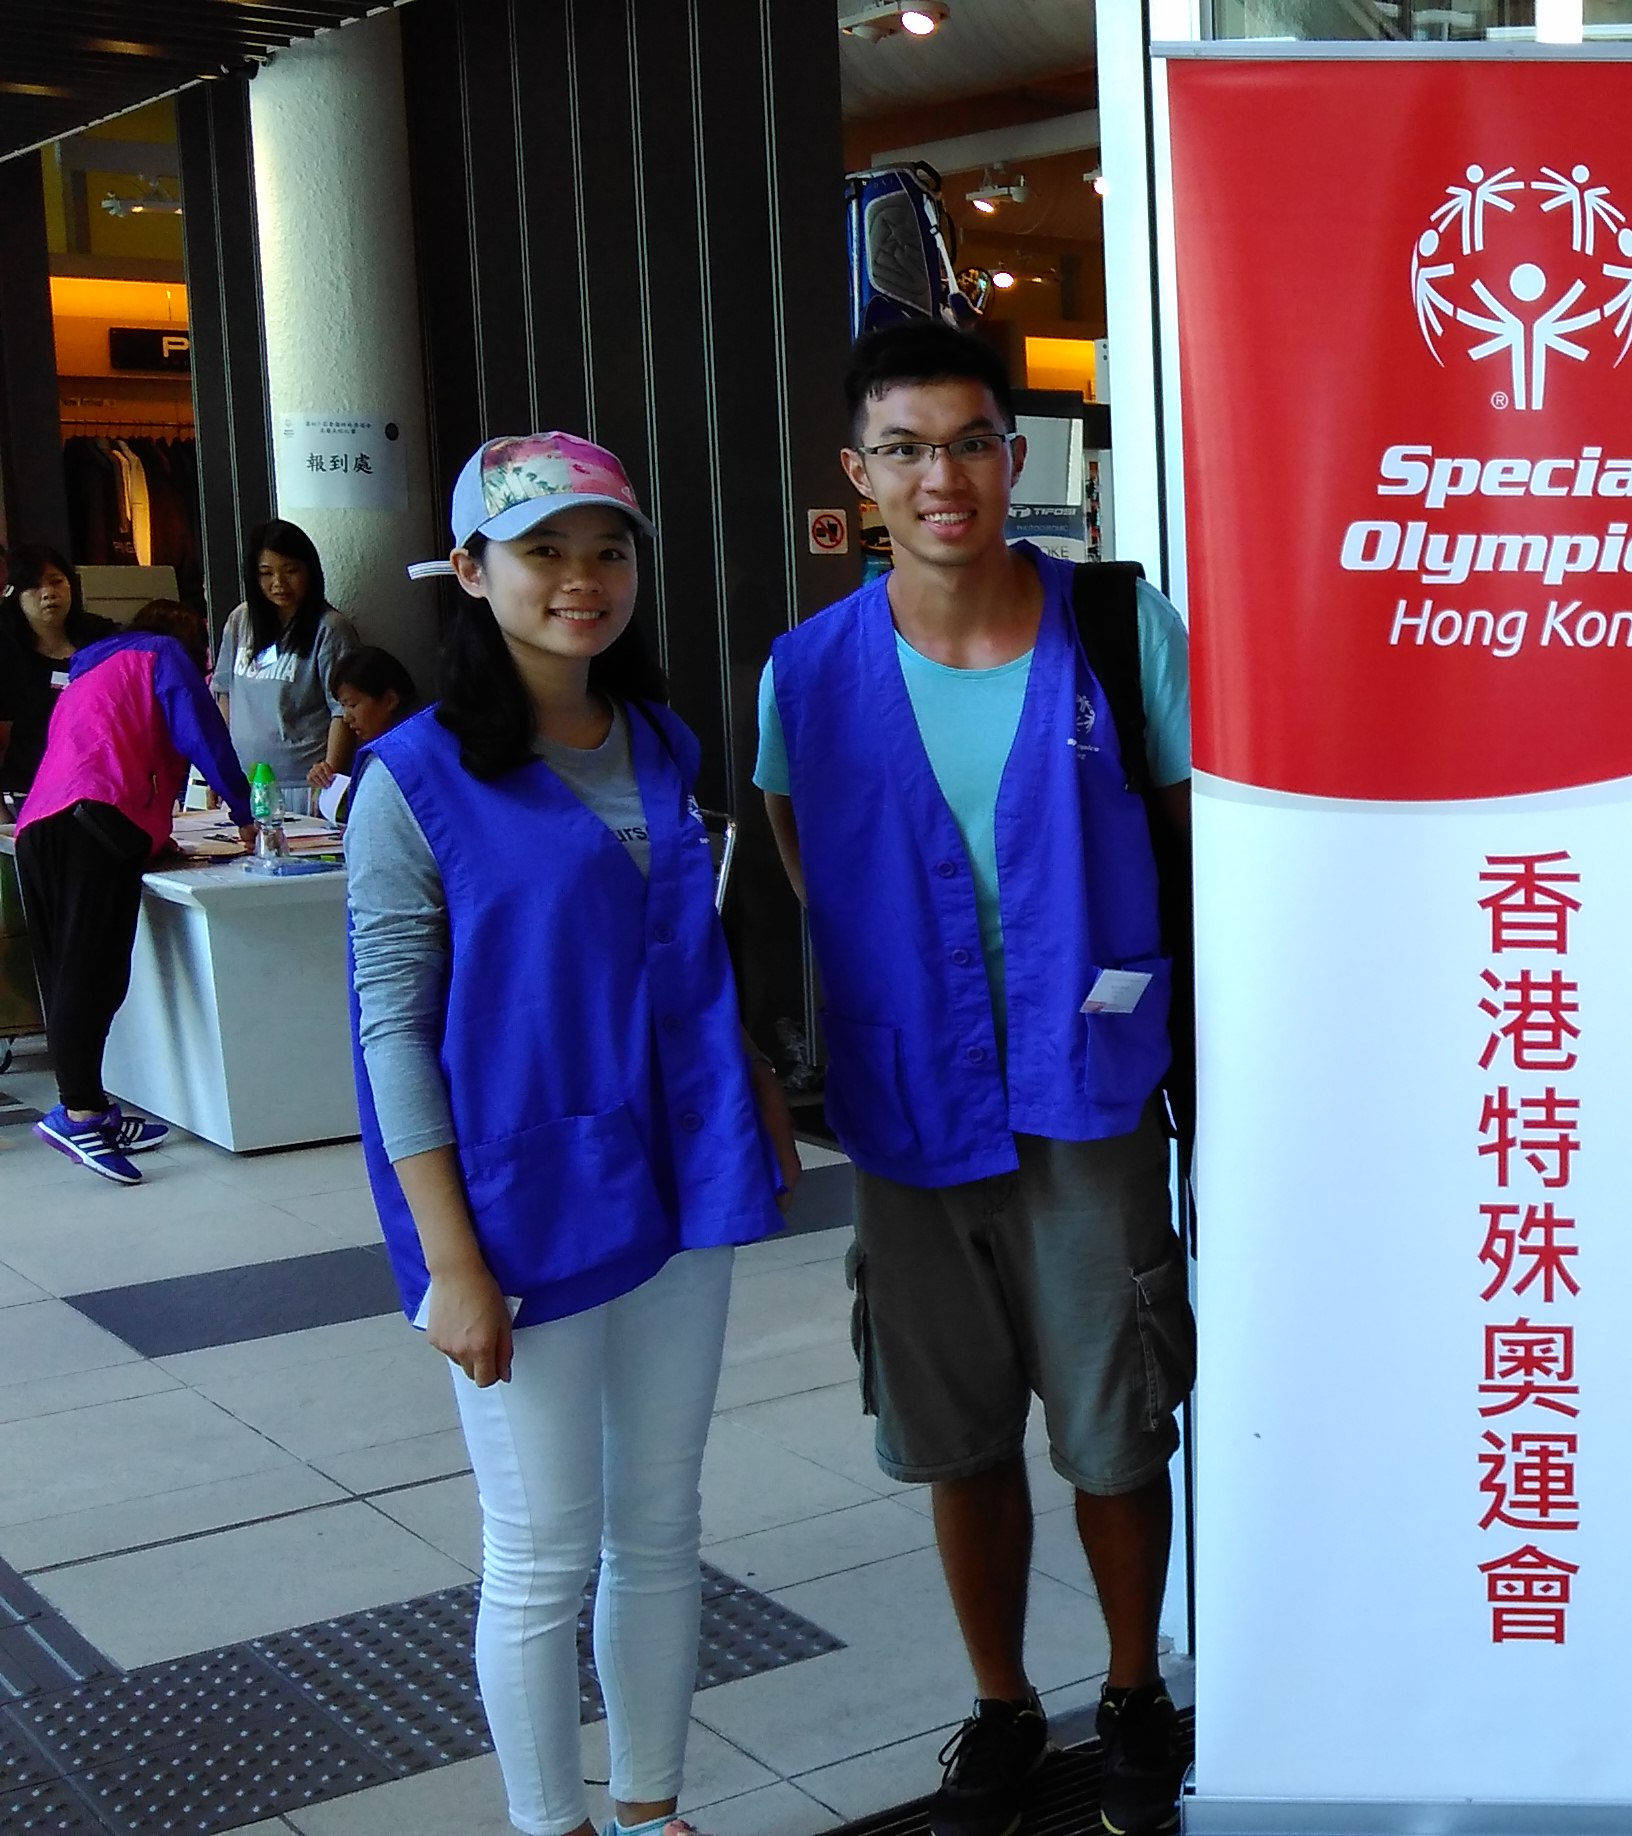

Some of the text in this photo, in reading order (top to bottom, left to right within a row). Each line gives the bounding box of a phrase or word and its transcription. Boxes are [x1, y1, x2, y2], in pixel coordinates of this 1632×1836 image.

[306, 452, 374, 475] 報到處
[1033, 507, 1077, 516] TIFOSI
[1390, 599, 1529, 658] Hong
[1478, 851, 1580, 1644] 香港特殊奧運會
